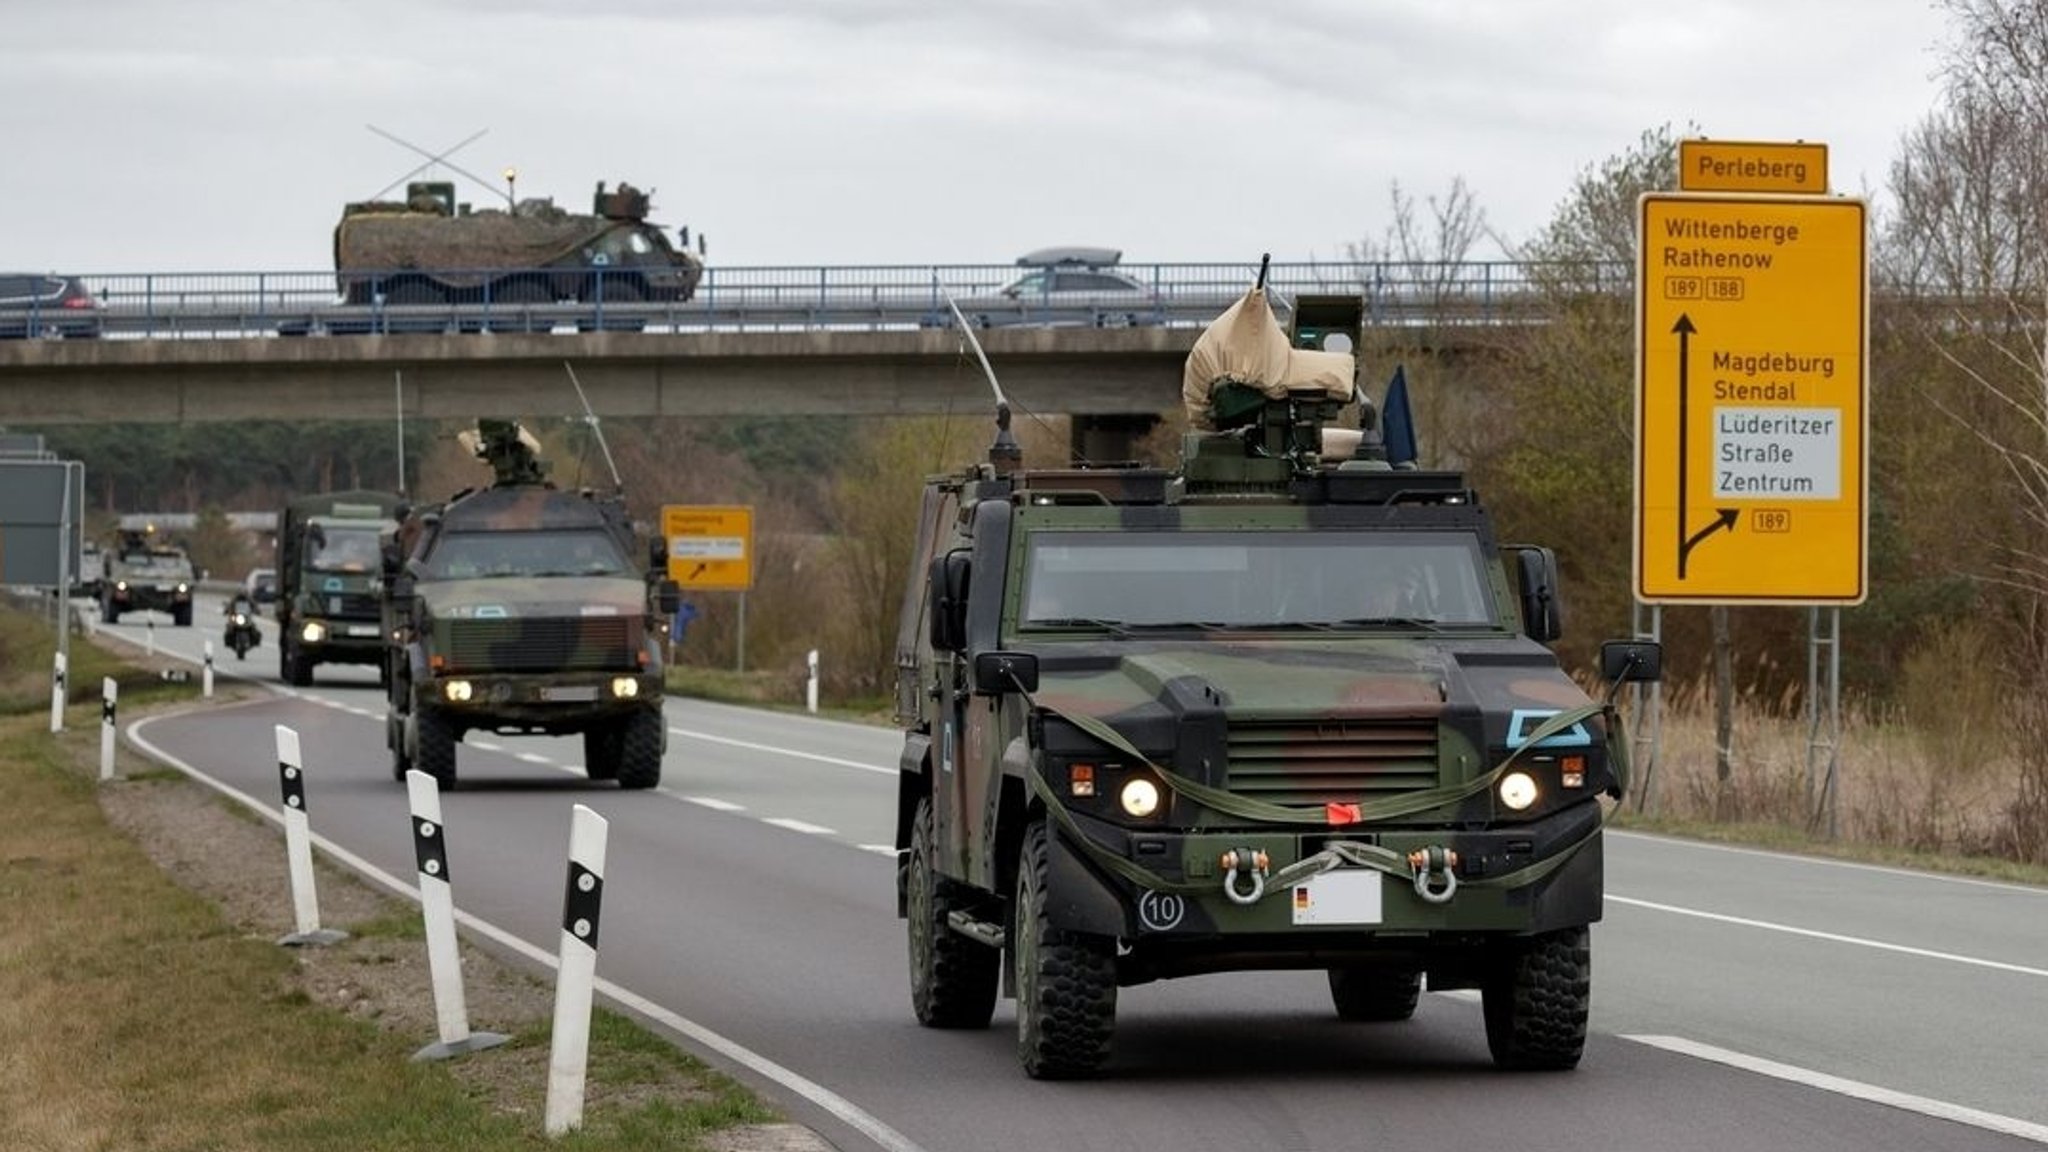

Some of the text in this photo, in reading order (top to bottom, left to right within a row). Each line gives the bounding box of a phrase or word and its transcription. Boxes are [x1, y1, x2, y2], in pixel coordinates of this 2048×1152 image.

[1699, 156, 1806, 183] Perleberg
[1665, 218, 1799, 245] Wittenberge
[1664, 247, 1773, 268] Rathenow
[1671, 280, 1738, 296] 189 188
[1713, 352, 1834, 377] Magdeburg
[1714, 380, 1796, 400] Stendal
[1720, 414, 1833, 435] Lüderitzer
[1721, 443, 1793, 463] Straße
[1720, 472, 1813, 492] Zentrum
[1759, 513, 1785, 528] 189
[1149, 896, 1174, 920] 10
